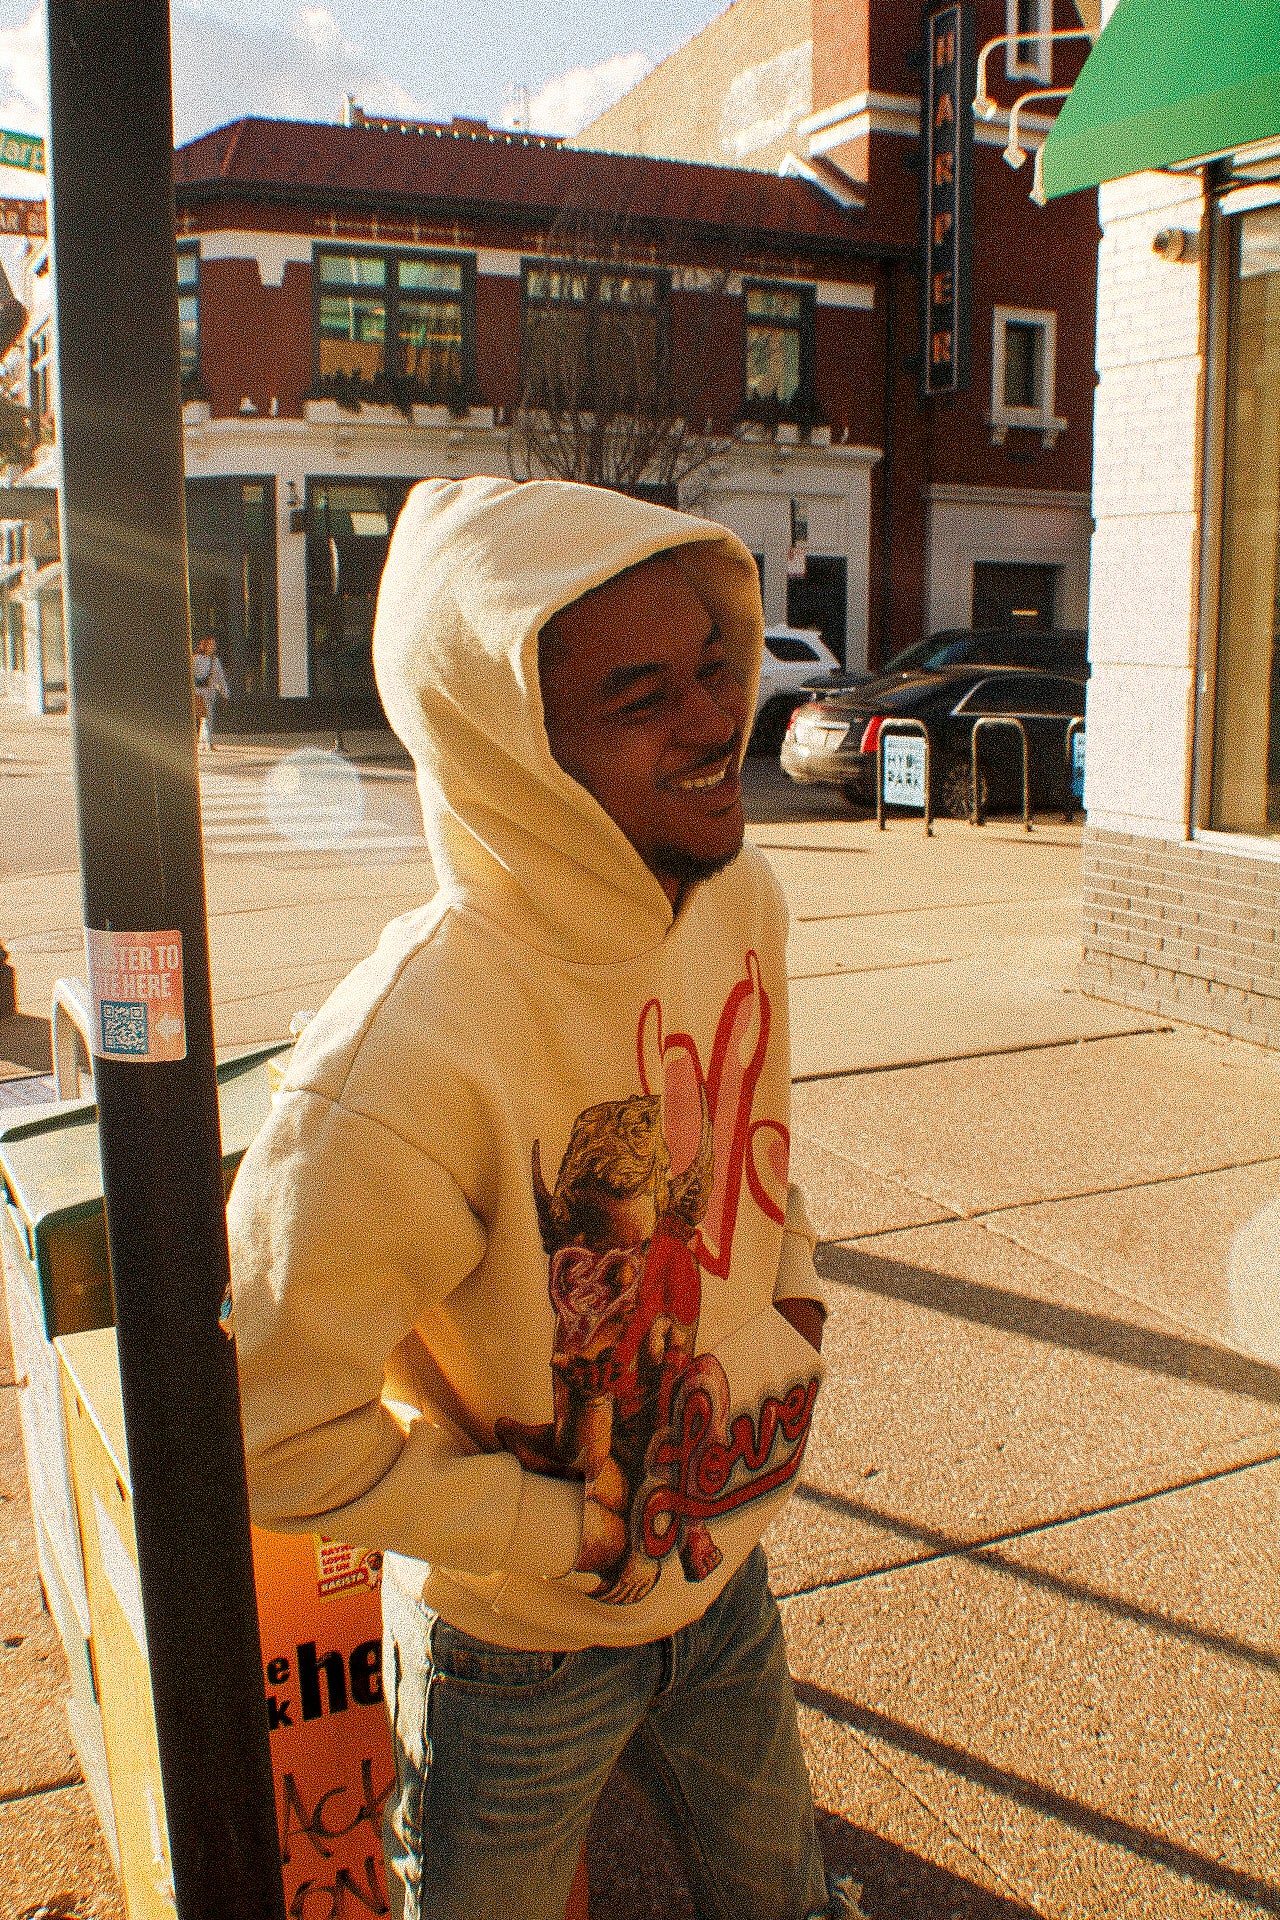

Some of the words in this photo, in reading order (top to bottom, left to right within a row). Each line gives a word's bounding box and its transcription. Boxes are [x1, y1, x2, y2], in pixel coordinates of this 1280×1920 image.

[934, 31, 953, 362] HARPER
[155, 944, 178, 970] TO
[122, 972, 171, 998] HERE
